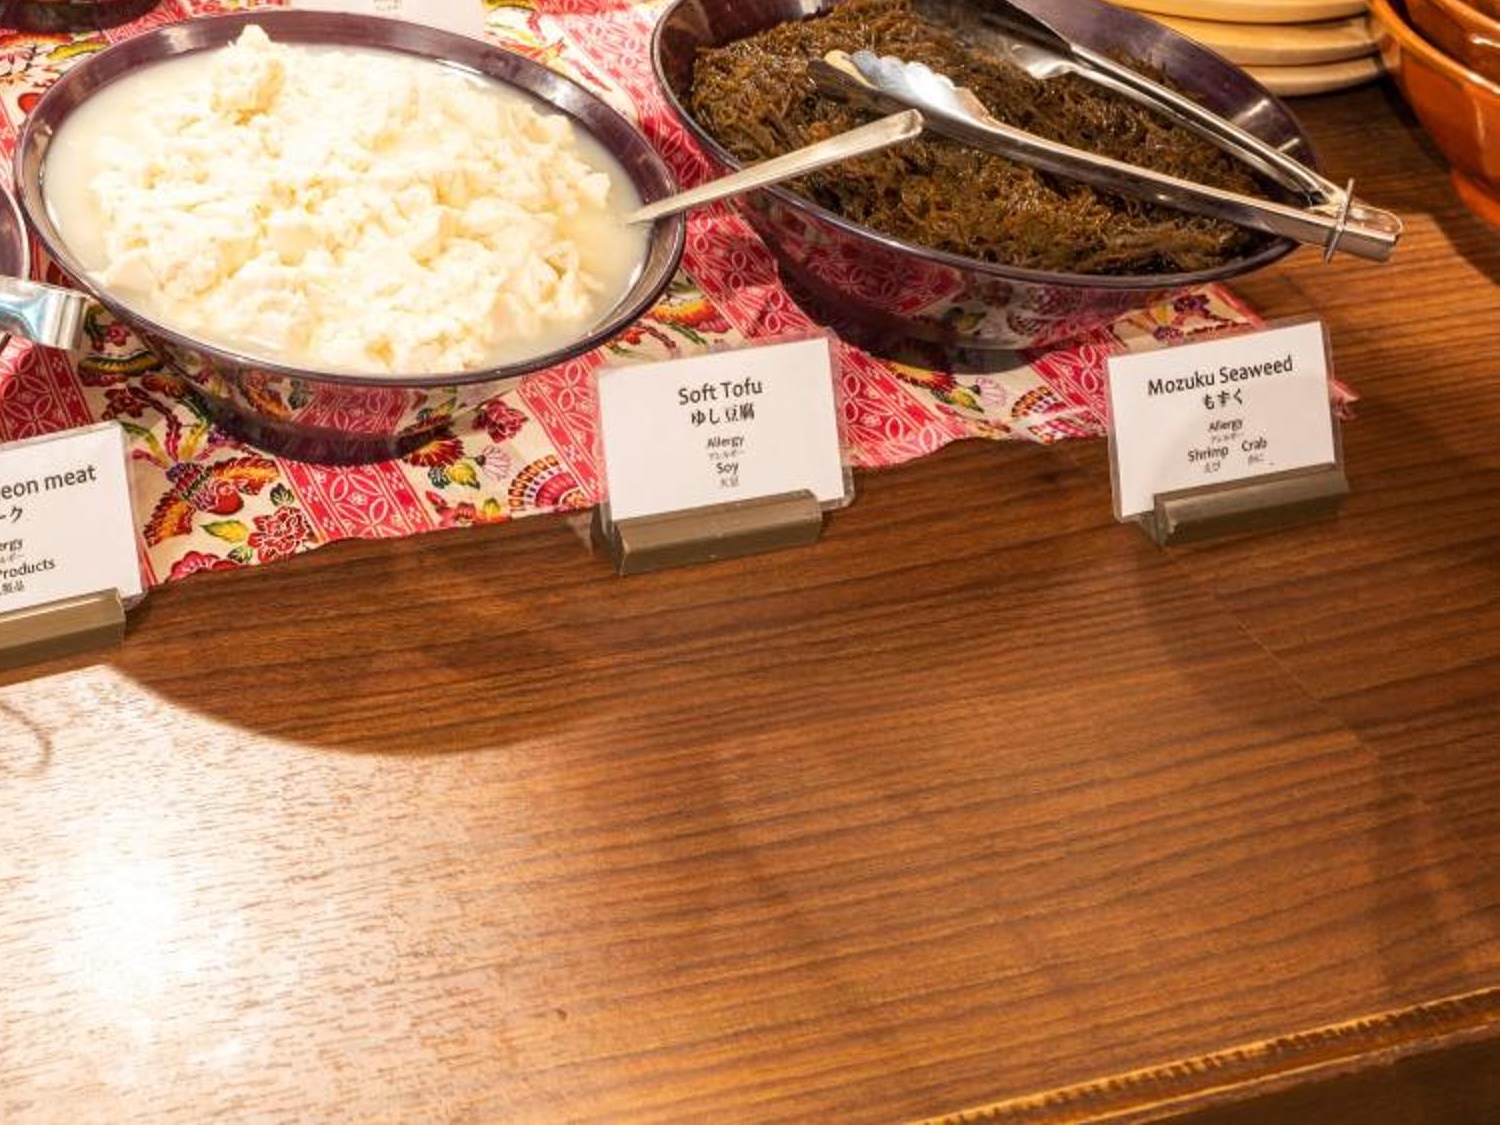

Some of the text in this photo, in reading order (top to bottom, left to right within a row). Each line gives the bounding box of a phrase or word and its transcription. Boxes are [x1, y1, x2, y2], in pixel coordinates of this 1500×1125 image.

[1147, 355, 1293, 395] Mozuku Seaweed
[678, 377, 763, 405] Soft Tofu
[1204, 388, 1243, 410] もずく
[691, 402, 755, 426] ゆし豆腐
[1208, 417, 1243, 432] Allergy
[707, 436, 745, 450] Allergy
[1187, 436, 1268, 463] Shrimp Crab
[45, 464, 97, 490] meat
[716, 462, 739, 476] Soy
